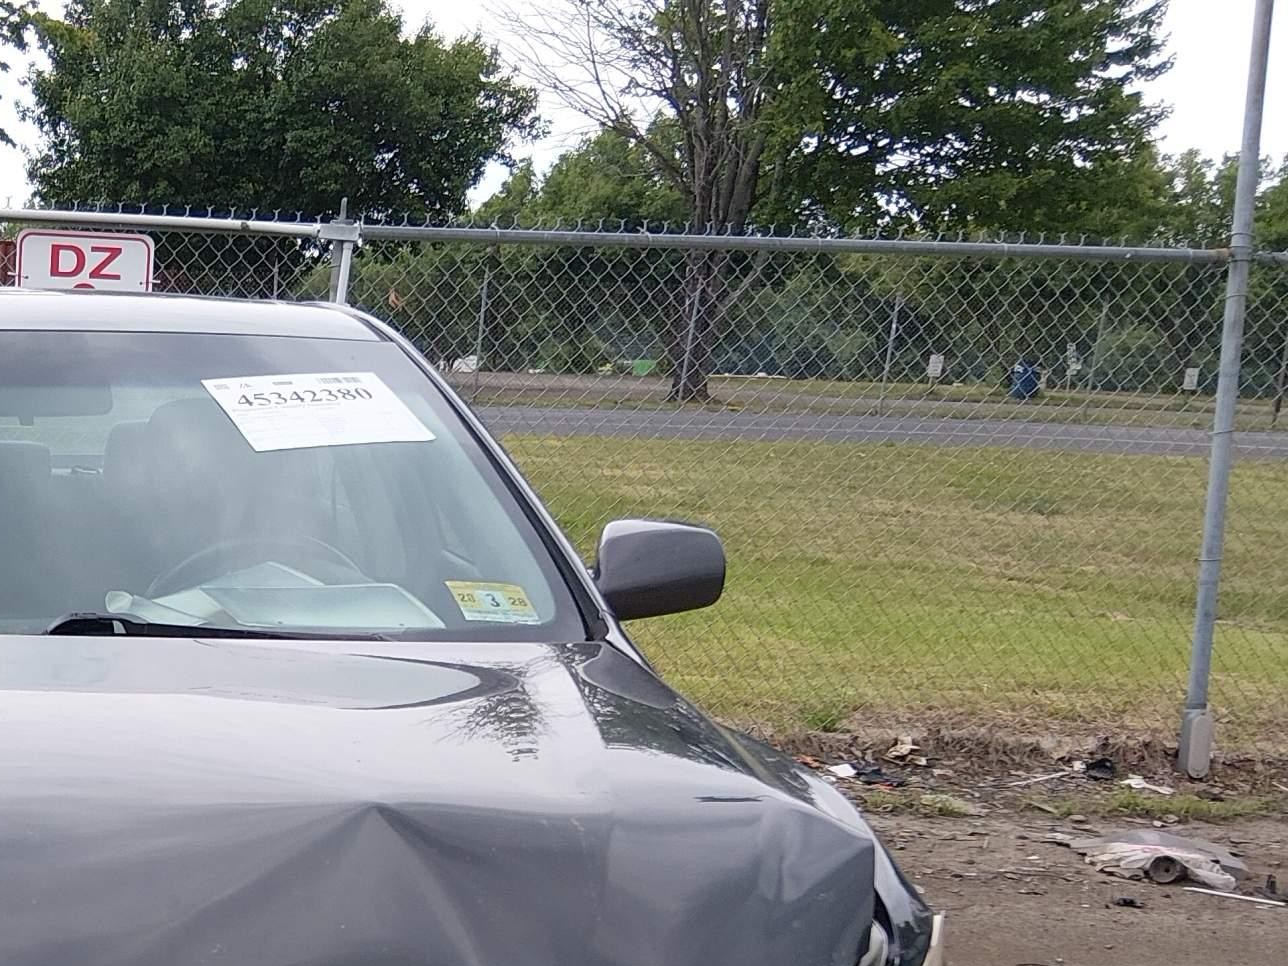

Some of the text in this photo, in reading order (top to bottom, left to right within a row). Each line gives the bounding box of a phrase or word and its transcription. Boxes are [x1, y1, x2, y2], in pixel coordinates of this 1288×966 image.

[50, 244, 122, 280] DZ
[237, 387, 373, 407] 45342380
[485, 593, 500, 608] 3
